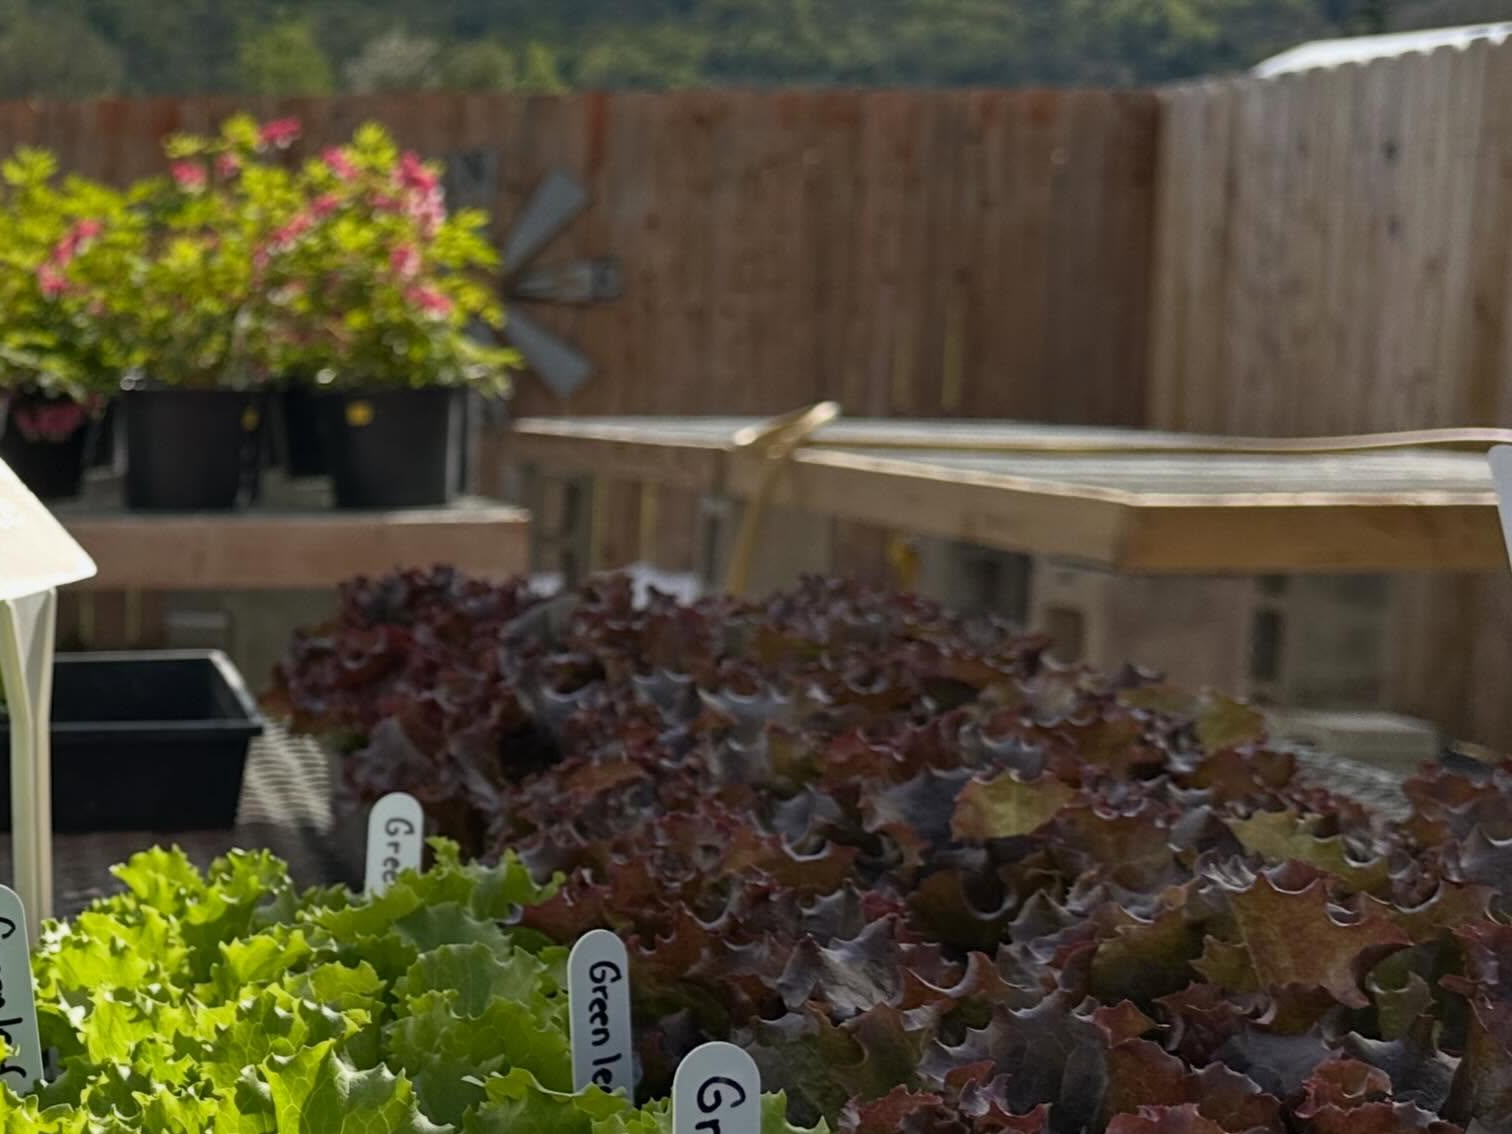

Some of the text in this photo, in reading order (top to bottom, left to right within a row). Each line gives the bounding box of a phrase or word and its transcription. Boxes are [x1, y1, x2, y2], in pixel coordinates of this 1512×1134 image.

[383, 816, 415, 884] Gree
[588, 960, 622, 1093] Green le
